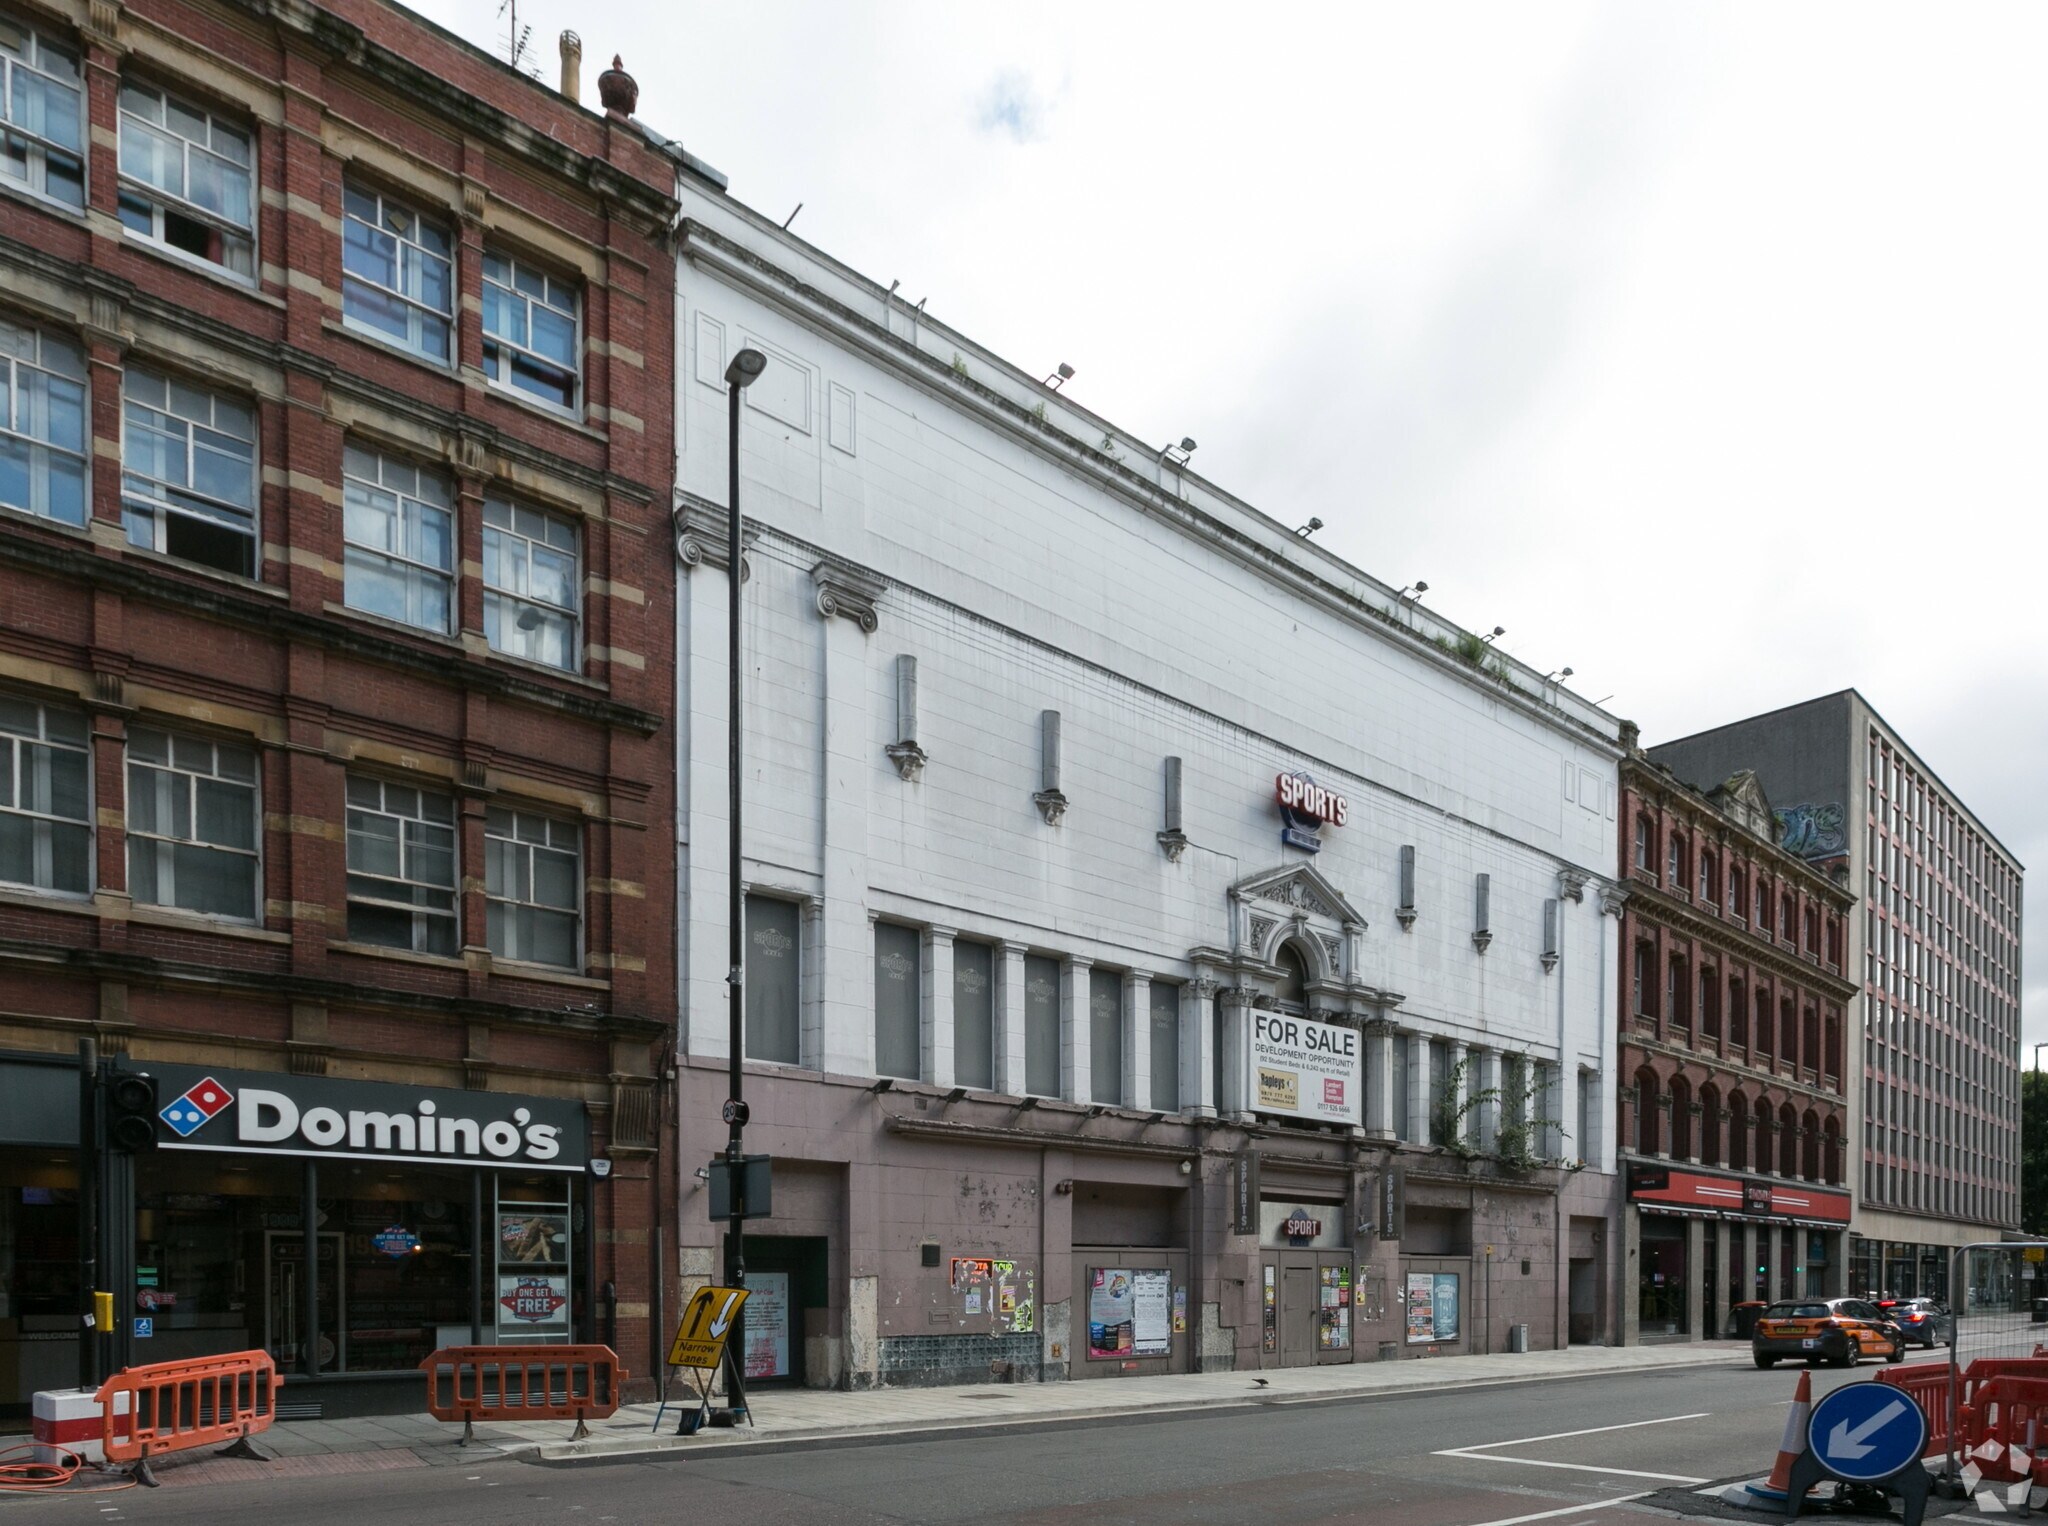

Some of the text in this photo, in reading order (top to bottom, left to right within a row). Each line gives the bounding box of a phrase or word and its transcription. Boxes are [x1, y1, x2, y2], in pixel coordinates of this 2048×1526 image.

[1280, 772, 1348, 826] SPORTS
[1255, 1015, 1355, 1057] FOR SALE
[1255, 1043, 1355, 1069] DEVELOPMENT OPPORTUNITY
[1268, 1057, 1287, 1066] Student
[1260, 1072, 1285, 1090] Rapleys
[724, 1105, 734, 1118] 20
[1318, 1102, 1328, 1110] 0117
[237, 1088, 560, 1161] Domino's
[1240, 1160, 1248, 1226] SPORTS
[1288, 1220, 1317, 1235] SPORT
[737, 1270, 743, 1278] 3
[502, 1288, 566, 1297] BUY ONE GET ONE
[516, 1298, 551, 1313] FREE
[678, 1342, 717, 1353] Narrow
[678, 1352, 708, 1364] Lanes
